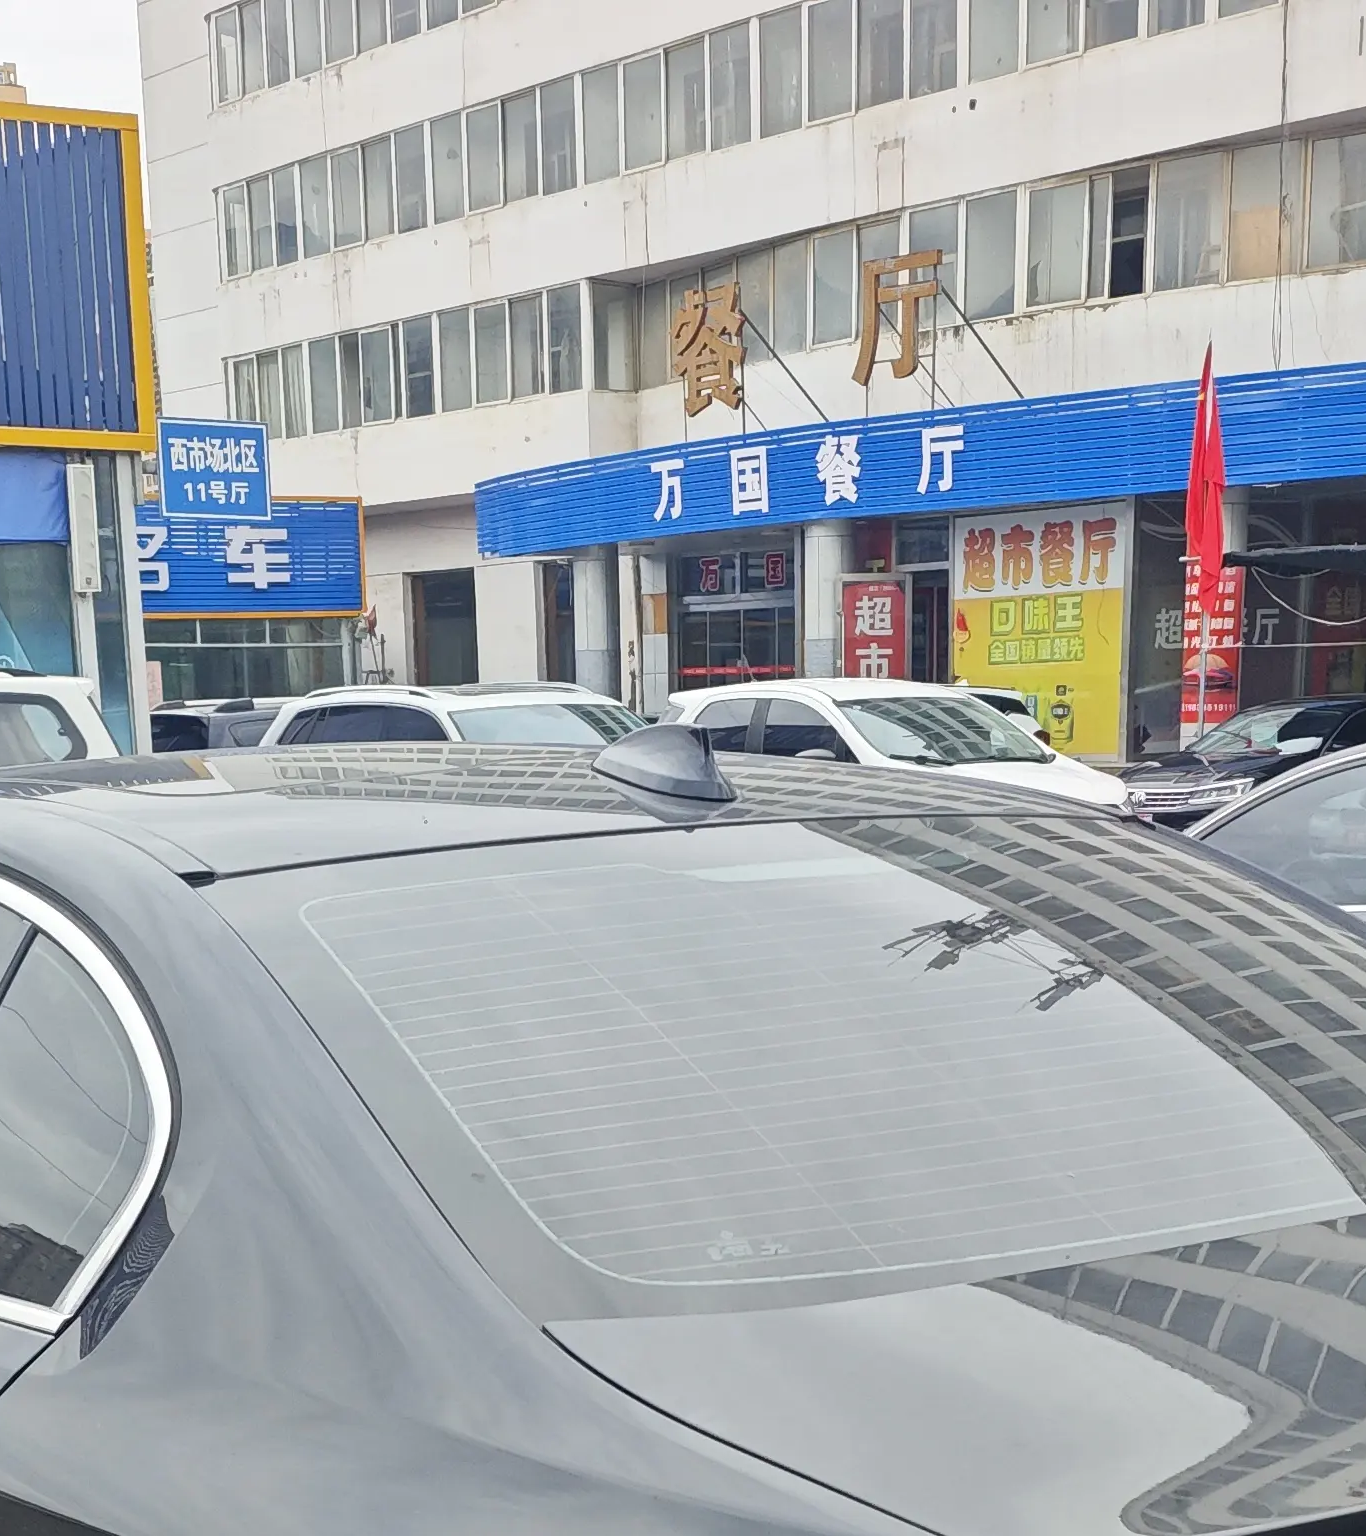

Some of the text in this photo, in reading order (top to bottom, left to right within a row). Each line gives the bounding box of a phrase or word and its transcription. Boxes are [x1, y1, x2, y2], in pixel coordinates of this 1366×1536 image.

[670, 249, 943, 418] 餐厅
[167, 436, 260, 474] 西市场北区
[650, 424, 965, 521] 万国餐厅
[183, 480, 249, 505] 11号厅
[699, 551, 786, 593] 万国
[963, 517, 1118, 594] 超市餐厅
[990, 594, 1084, 636] 口味王
[1155, 607, 1280, 650] 超厅
[854, 596, 894, 679] 超市
[988, 635, 1085, 665] 全国销量领先
